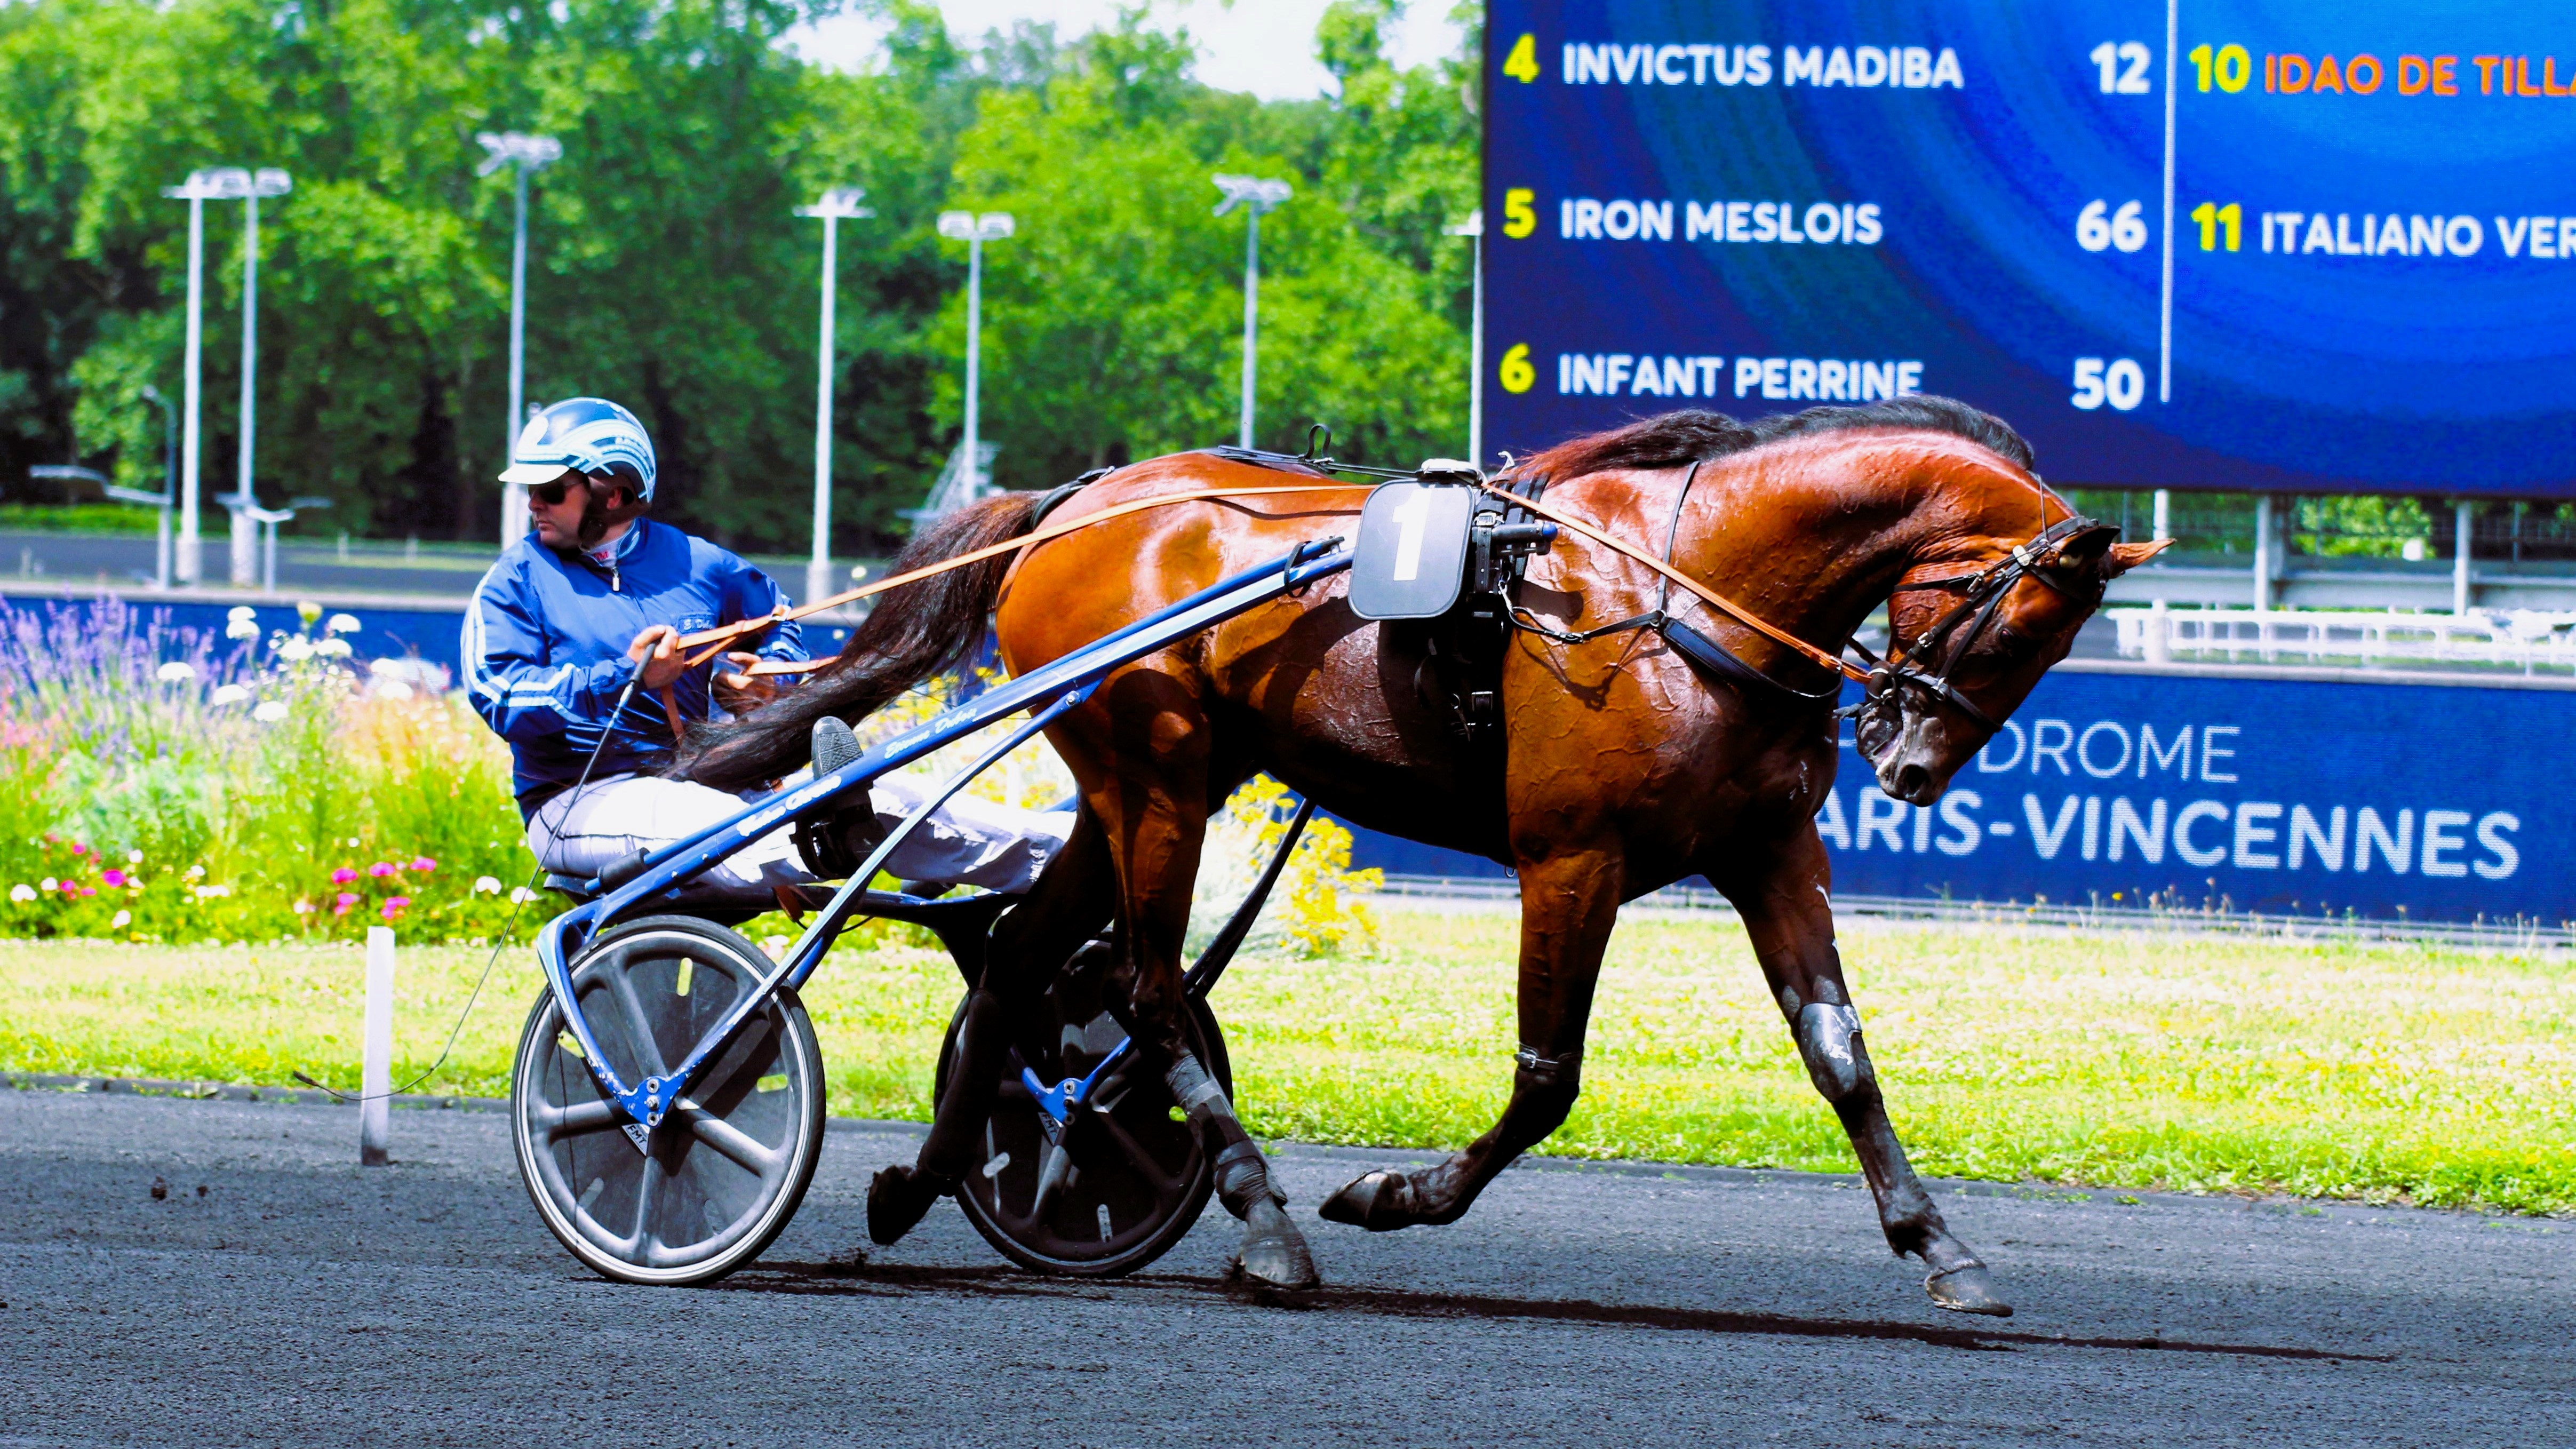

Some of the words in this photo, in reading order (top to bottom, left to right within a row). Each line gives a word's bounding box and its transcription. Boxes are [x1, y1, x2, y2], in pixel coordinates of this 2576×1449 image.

[1503, 34, 1540, 82] 4
[1564, 44, 1772, 86] INVICTUS
[1784, 45, 1965, 89] MADIBA
[2089, 41, 2151, 94] 12
[2188, 43, 2252, 93] 10
[2263, 53, 2384, 95] IDAO
[2397, 54, 2459, 97] DE
[2473, 54, 2576, 98] TILL
[1502, 188, 1536, 239] 5
[1561, 199, 1673, 241] IRON
[1686, 201, 1883, 245] MESLOIS
[2076, 199, 2148, 253] 66
[2191, 202, 2242, 252] 11
[2261, 212, 2484, 257] ITALIANO
[1500, 343, 1535, 394] 6
[1559, 354, 1724, 398] INFANT
[1735, 356, 1924, 401] PERRINE
[2071, 358, 2145, 411] 50
[1392, 488, 1432, 581] 1
[1838, 716, 2239, 783] DROME
[1814, 785, 2520, 879] ARIS-VINCENNES
[627, 1124, 647, 1144] FMT
